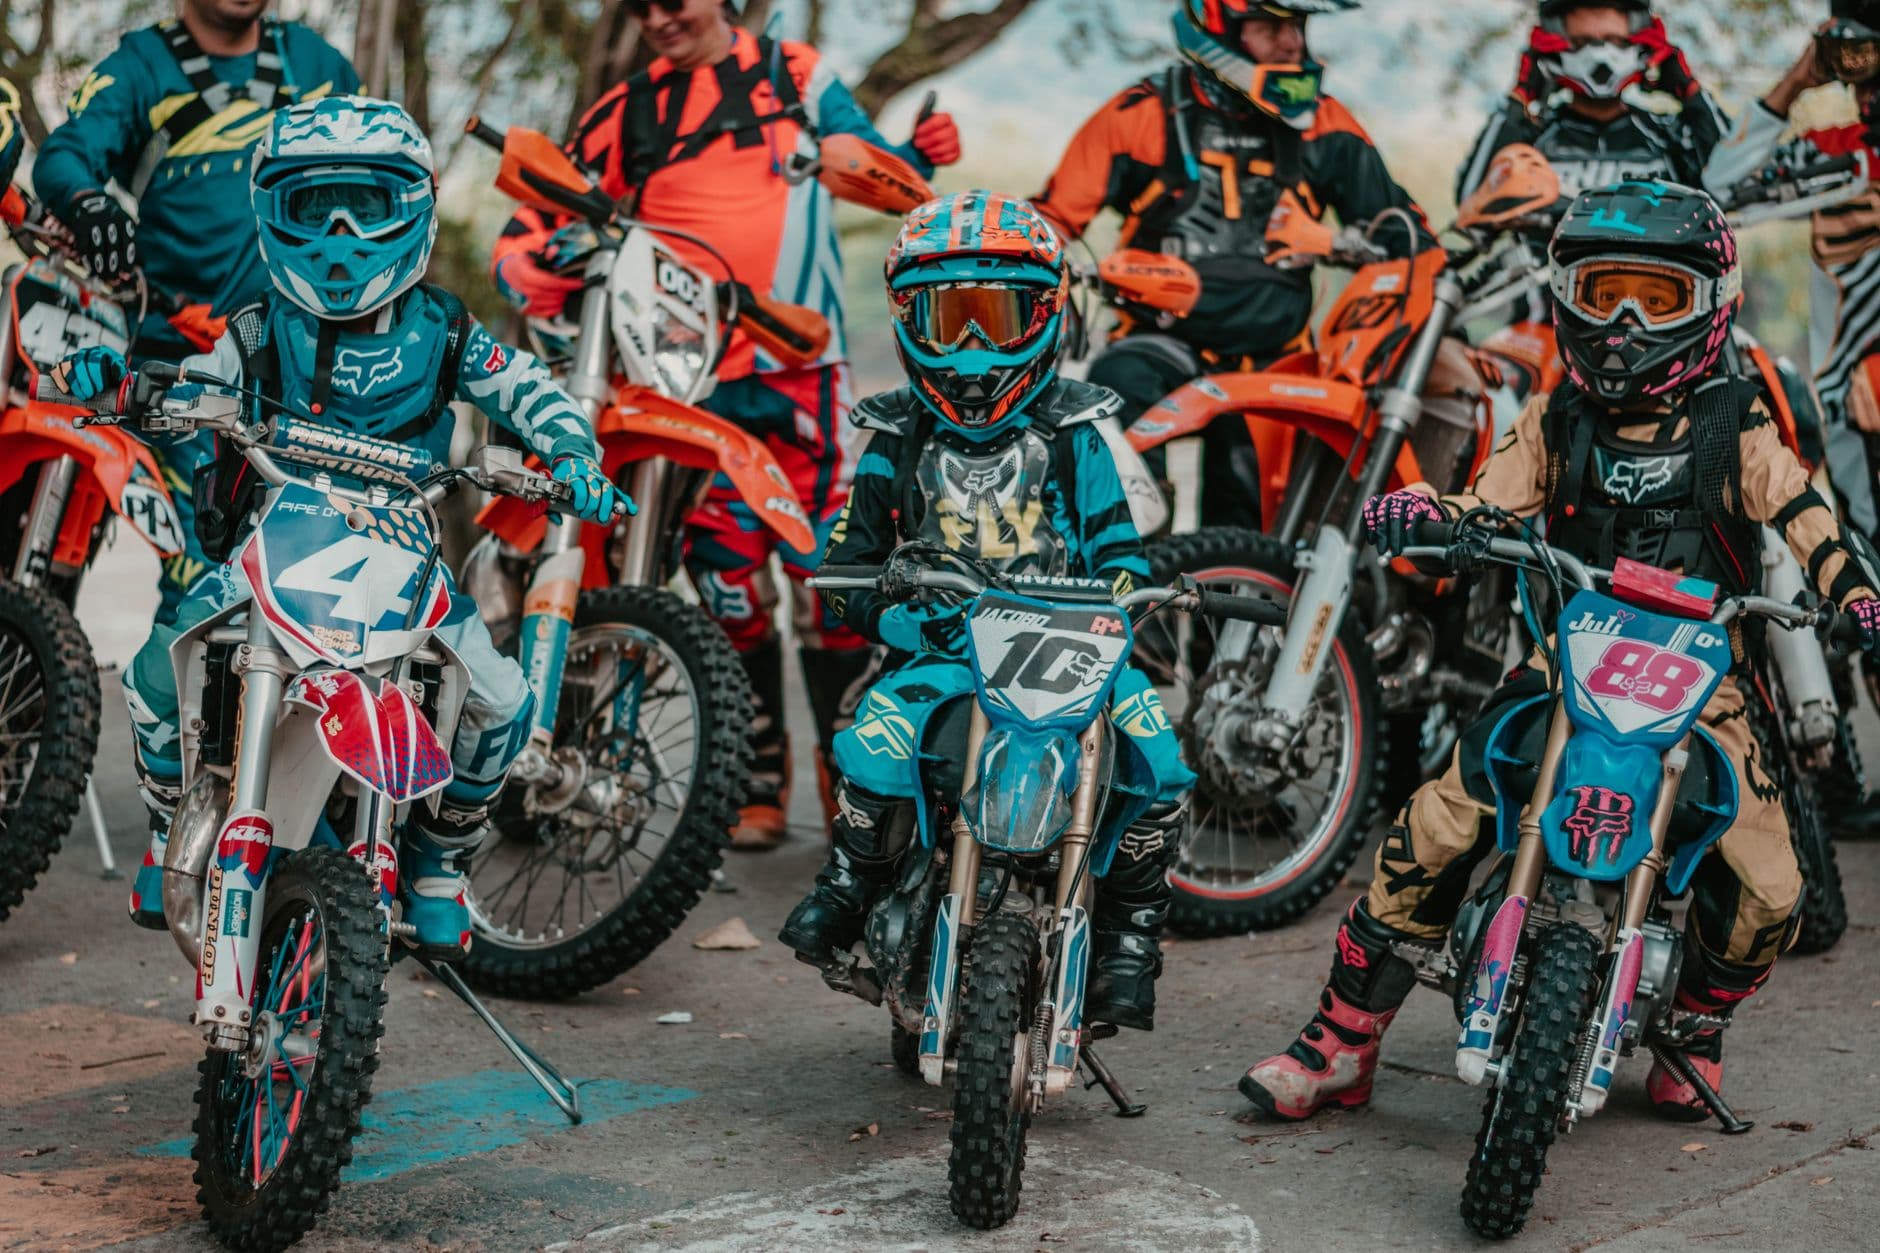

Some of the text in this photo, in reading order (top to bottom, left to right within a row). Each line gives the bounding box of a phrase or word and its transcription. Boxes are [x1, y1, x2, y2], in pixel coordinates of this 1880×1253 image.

[286, 425, 415, 469] RENTHAL
[278, 501, 320, 515] PIPE
[935, 497, 1042, 559] FLY
[272, 534, 425, 628] 4
[979, 607, 1052, 626] JACOBO
[1568, 611, 1623, 635] Juli
[986, 631, 1102, 695] 10
[225, 827, 271, 846] KTM
